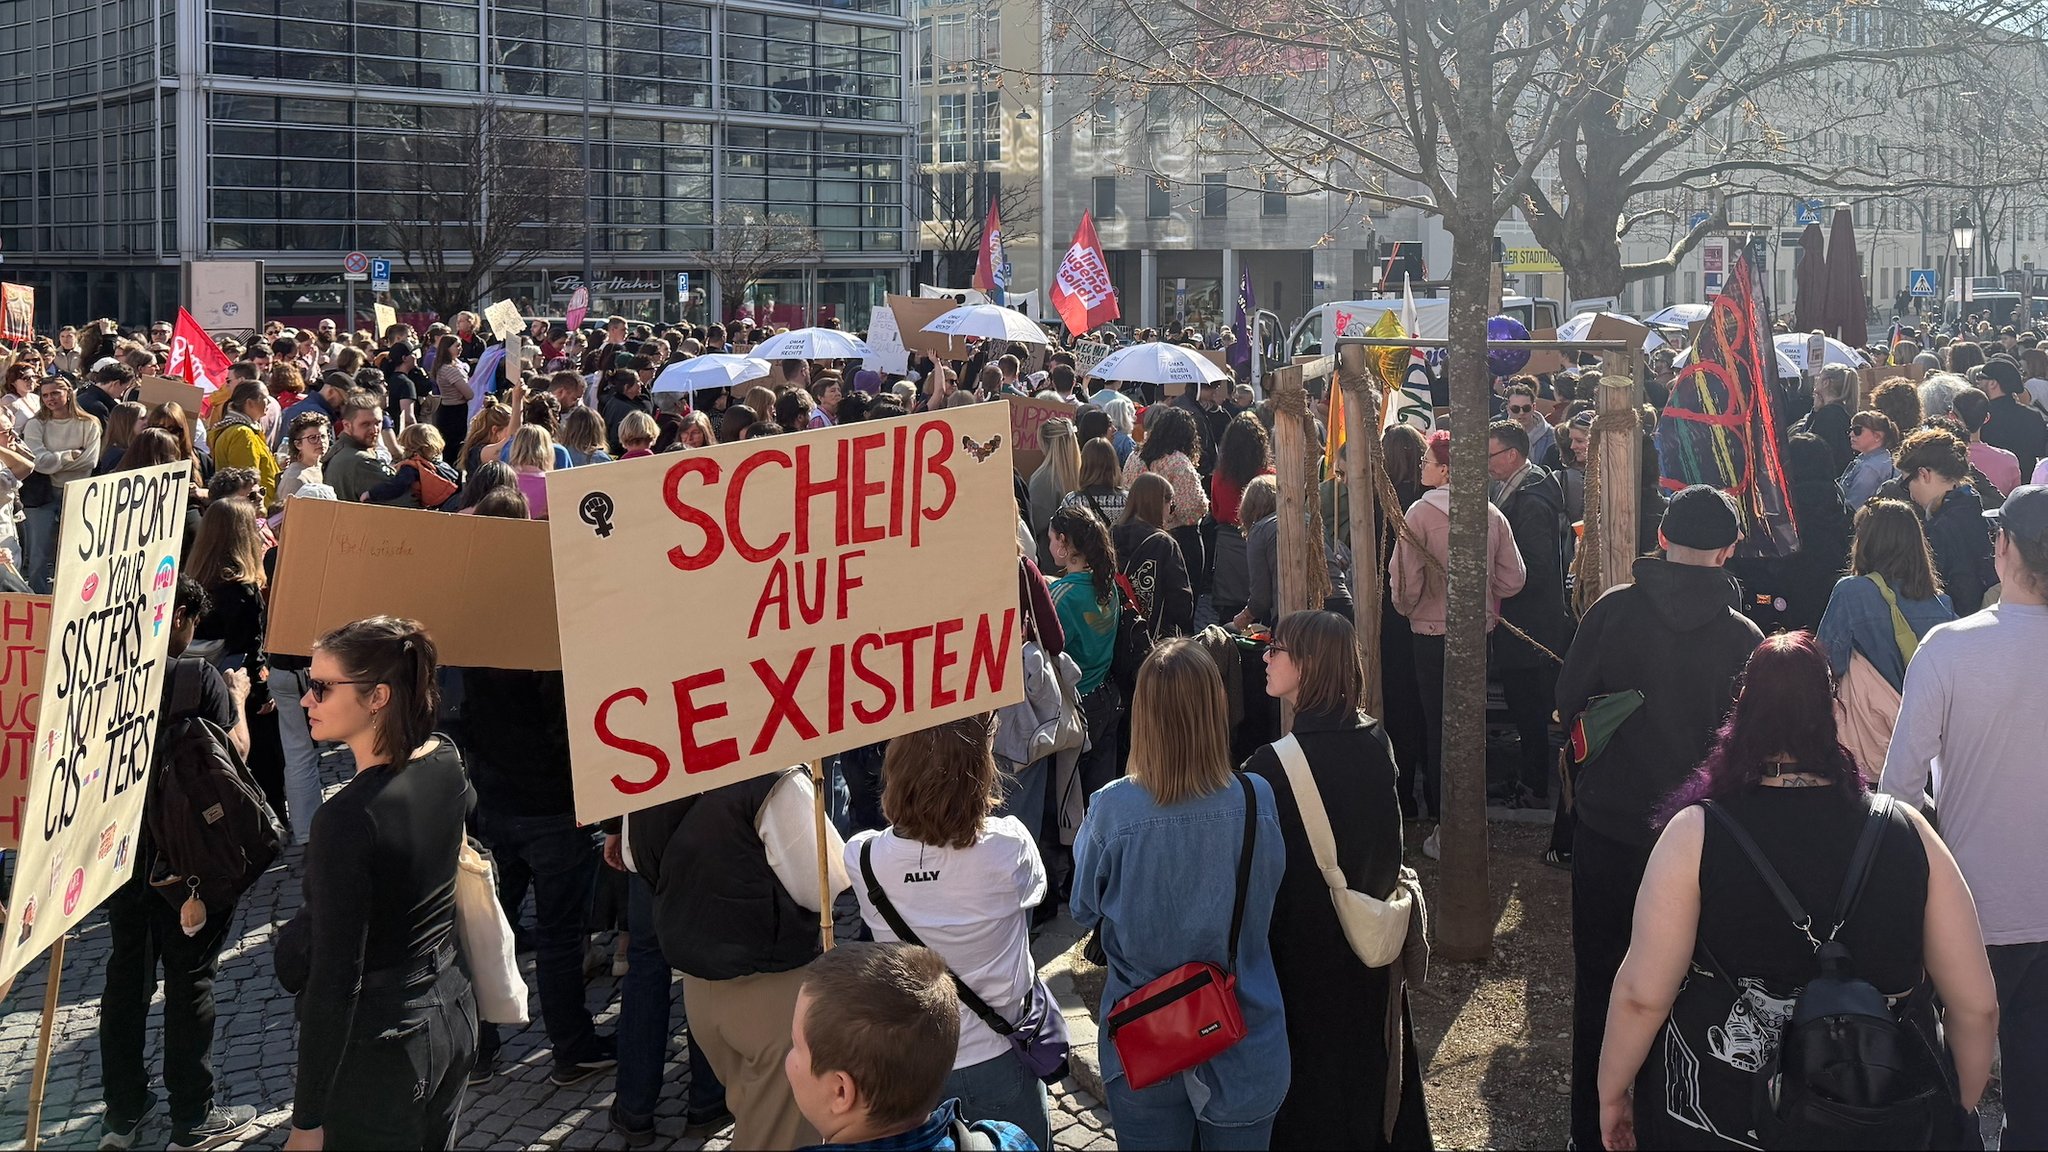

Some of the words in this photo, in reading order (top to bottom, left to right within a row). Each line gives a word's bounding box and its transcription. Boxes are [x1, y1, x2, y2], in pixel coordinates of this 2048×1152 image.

[374, 261, 385, 278] P
[608, 275, 661, 291] Hahn
[1079, 251, 1109, 286] links
[1519, 250, 1560, 264] STADTMUS
[1075, 343, 1092, 354] WEG
[79, 470, 187, 562] SUPPORT
[662, 420, 957, 572] SCHEIß
[105, 550, 146, 608] YOUR
[747, 550, 866, 639] AUF
[57, 593, 147, 699] SISTERS
[62, 679, 109, 756] NOT
[107, 659, 155, 731] JUST
[593, 608, 1016, 795] SEXISTEN
[904, 870, 940, 883] ALLY
